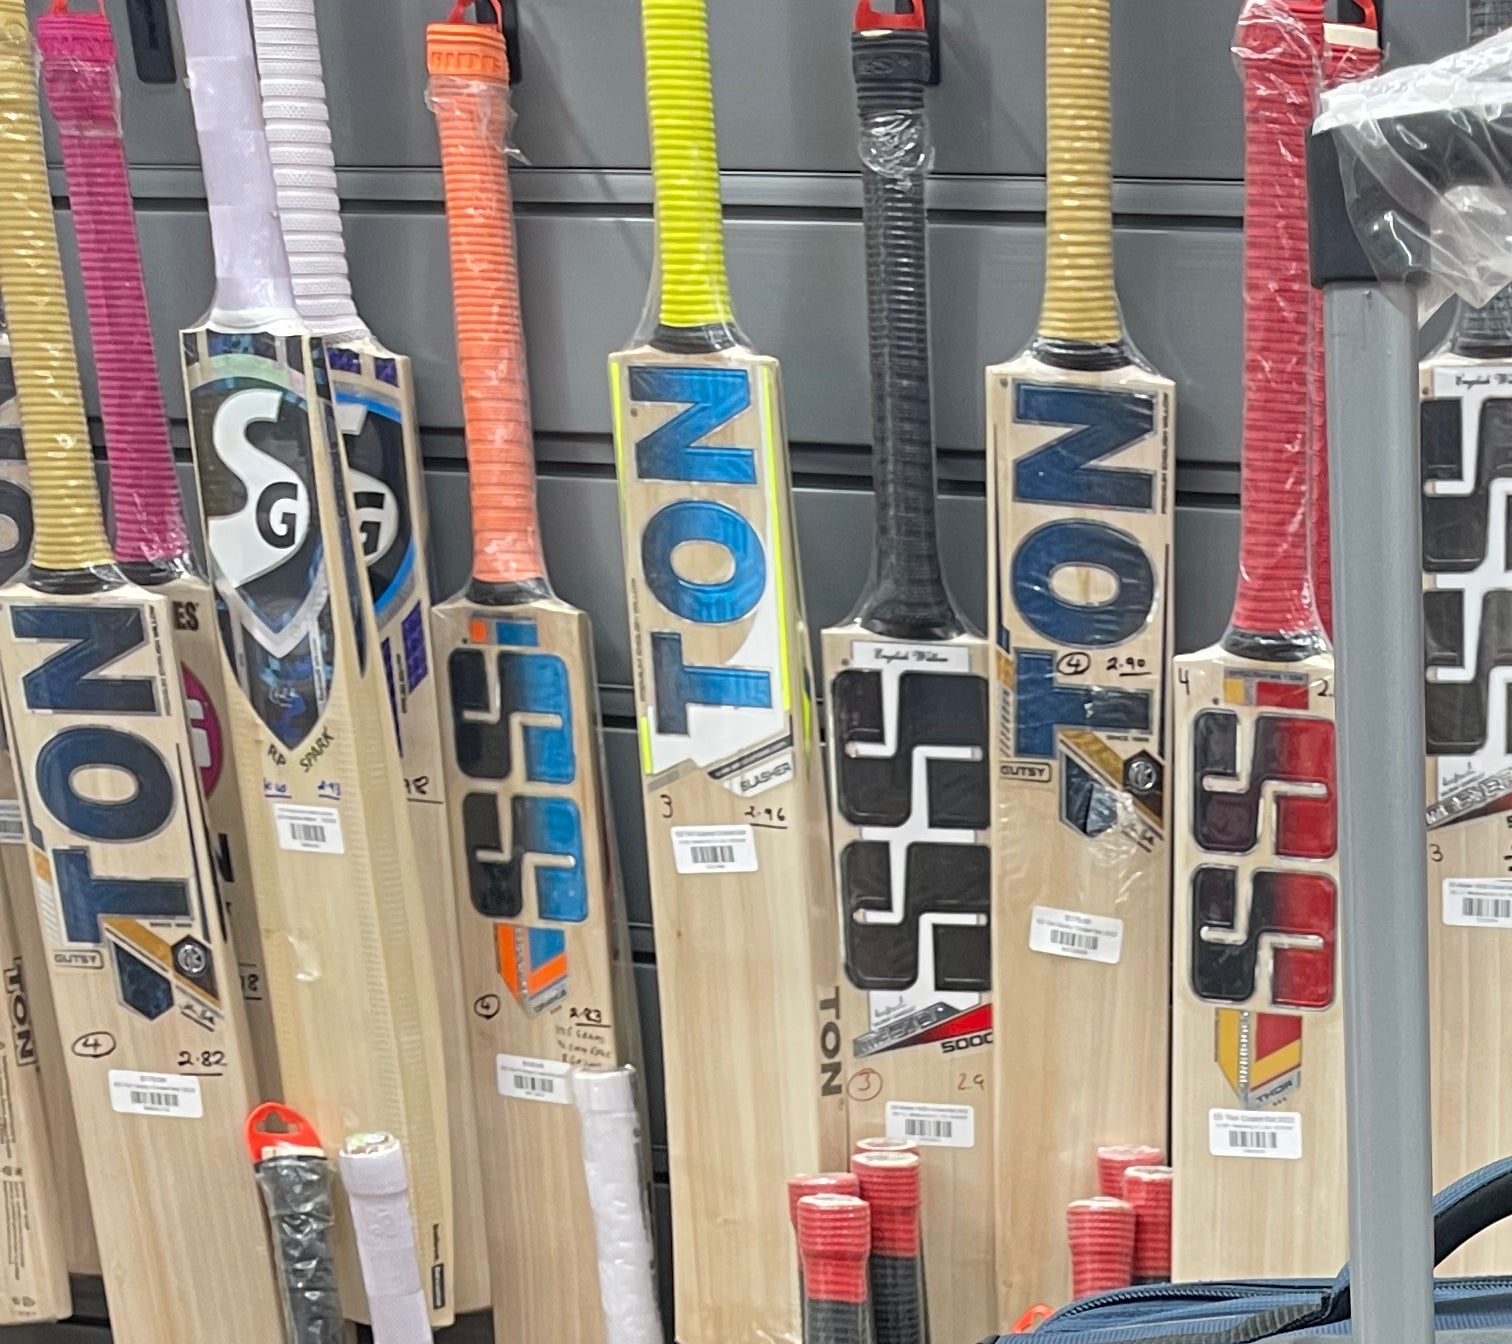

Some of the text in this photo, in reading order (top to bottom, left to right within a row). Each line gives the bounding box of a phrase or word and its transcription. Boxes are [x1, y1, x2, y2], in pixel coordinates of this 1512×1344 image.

[628, 365, 773, 736] TON
[1010, 378, 1159, 759] TON
[1067, 657, 1083, 672] 4
[1178, 667, 1190, 696] 4
[9, 602, 195, 946] TON
[1429, 843, 1444, 863] 3
[819, 985, 843, 1097] TON
[177, 1049, 228, 1067] 2.82
[1255, 1079, 1294, 1103] THOR
